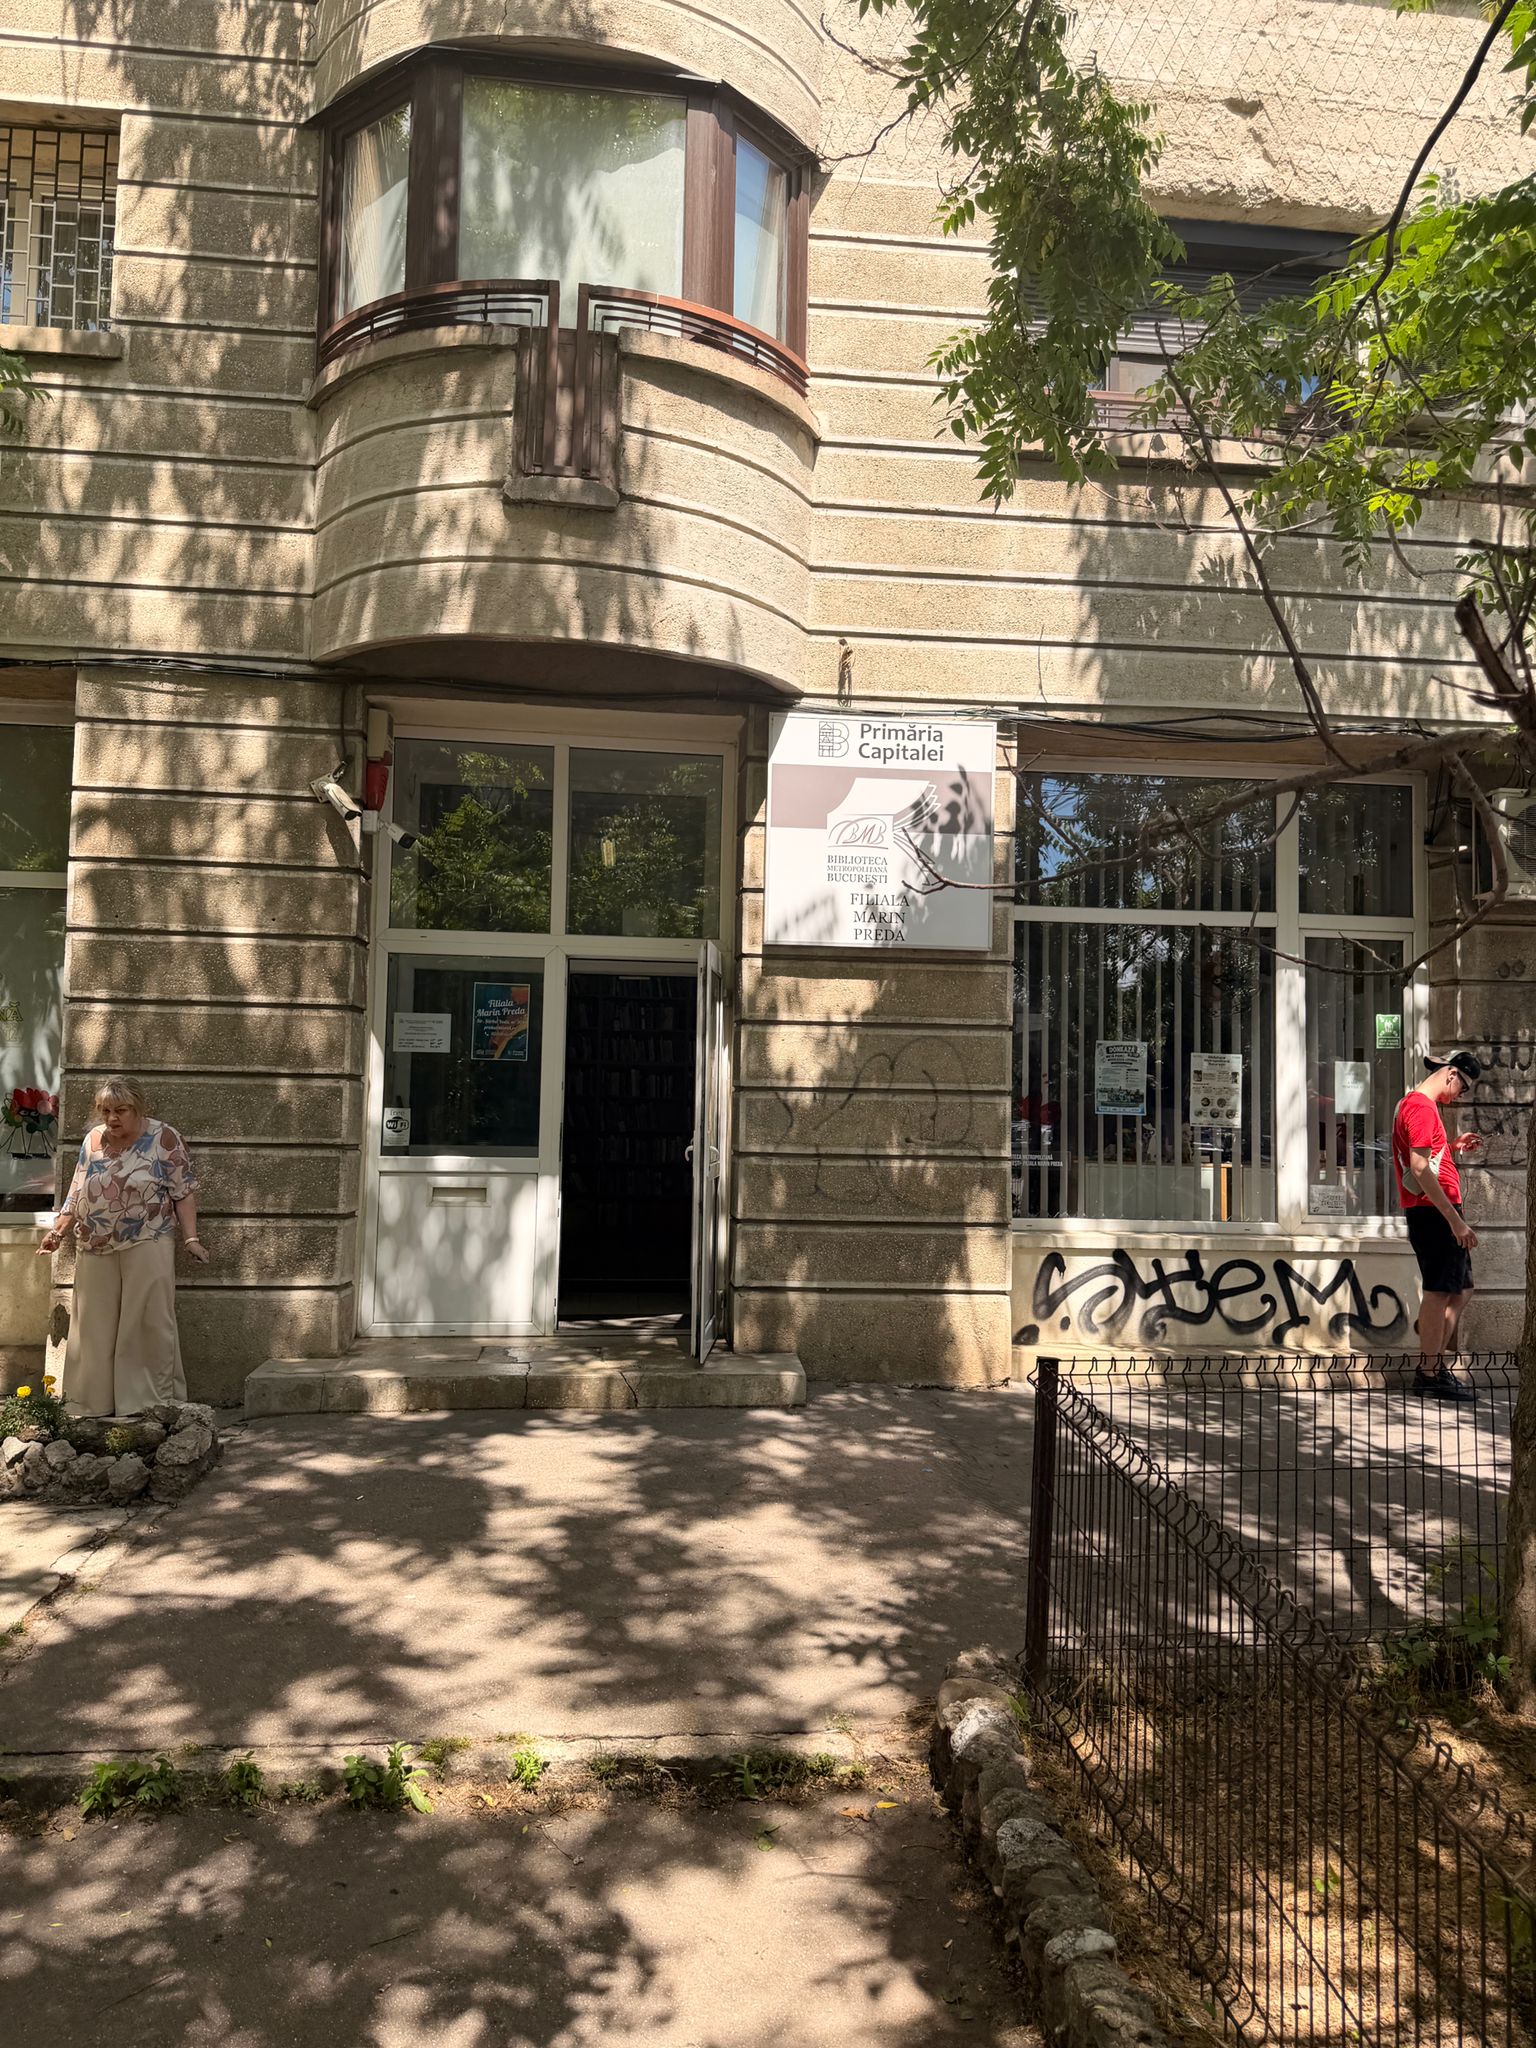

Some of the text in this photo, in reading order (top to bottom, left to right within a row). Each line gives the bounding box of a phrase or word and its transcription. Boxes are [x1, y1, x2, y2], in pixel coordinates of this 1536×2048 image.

[860, 723, 943, 742] Primăria
[858, 742, 944, 764] Capitalei
[827, 854, 888, 865] BIBLIOTECA
[850, 893, 910, 906] FILIALA
[853, 910, 906, 923] MARIN
[853, 928, 905, 941] PREDA
[488, 999, 514, 1008] Filiala
[477, 1007, 526, 1017] Marin Preda
